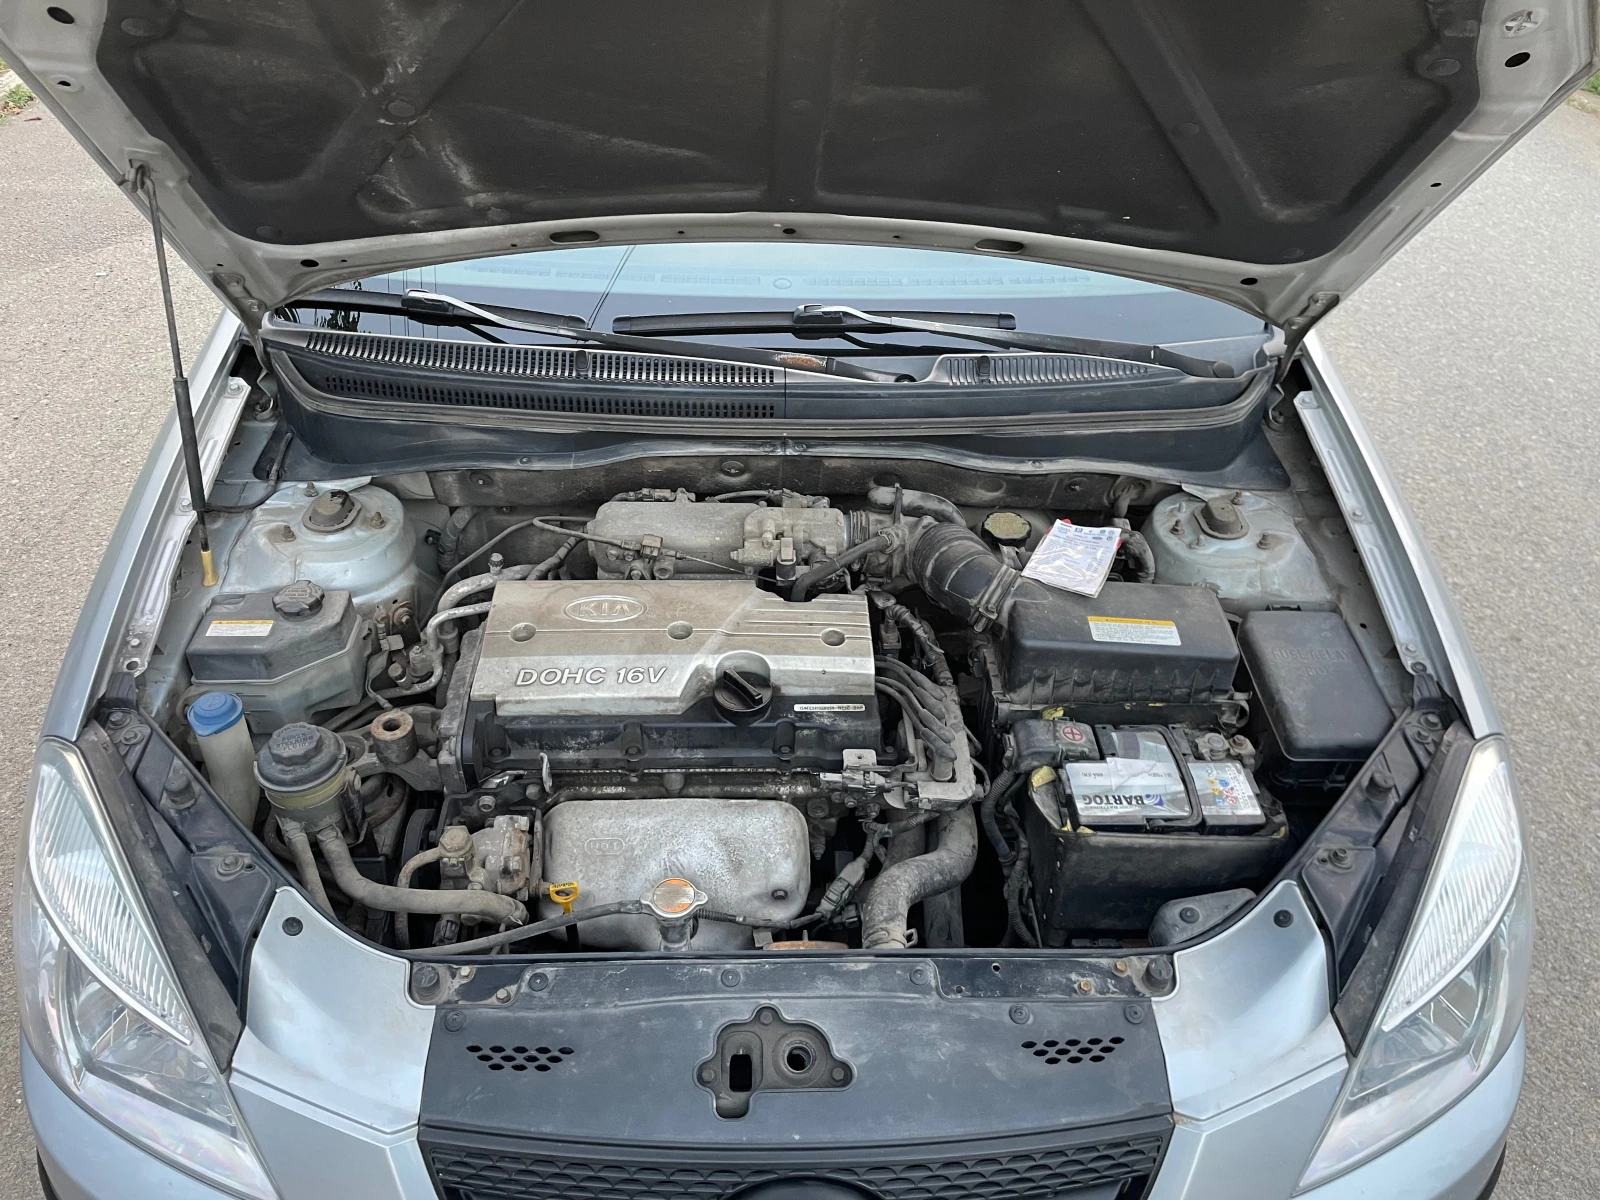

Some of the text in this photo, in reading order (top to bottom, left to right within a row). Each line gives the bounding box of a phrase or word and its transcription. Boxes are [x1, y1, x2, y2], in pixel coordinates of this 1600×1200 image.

[579, 602, 631, 617] KIA
[515, 666, 668, 687] DOHC 16V
[1082, 794, 1145, 805] BARTOG
